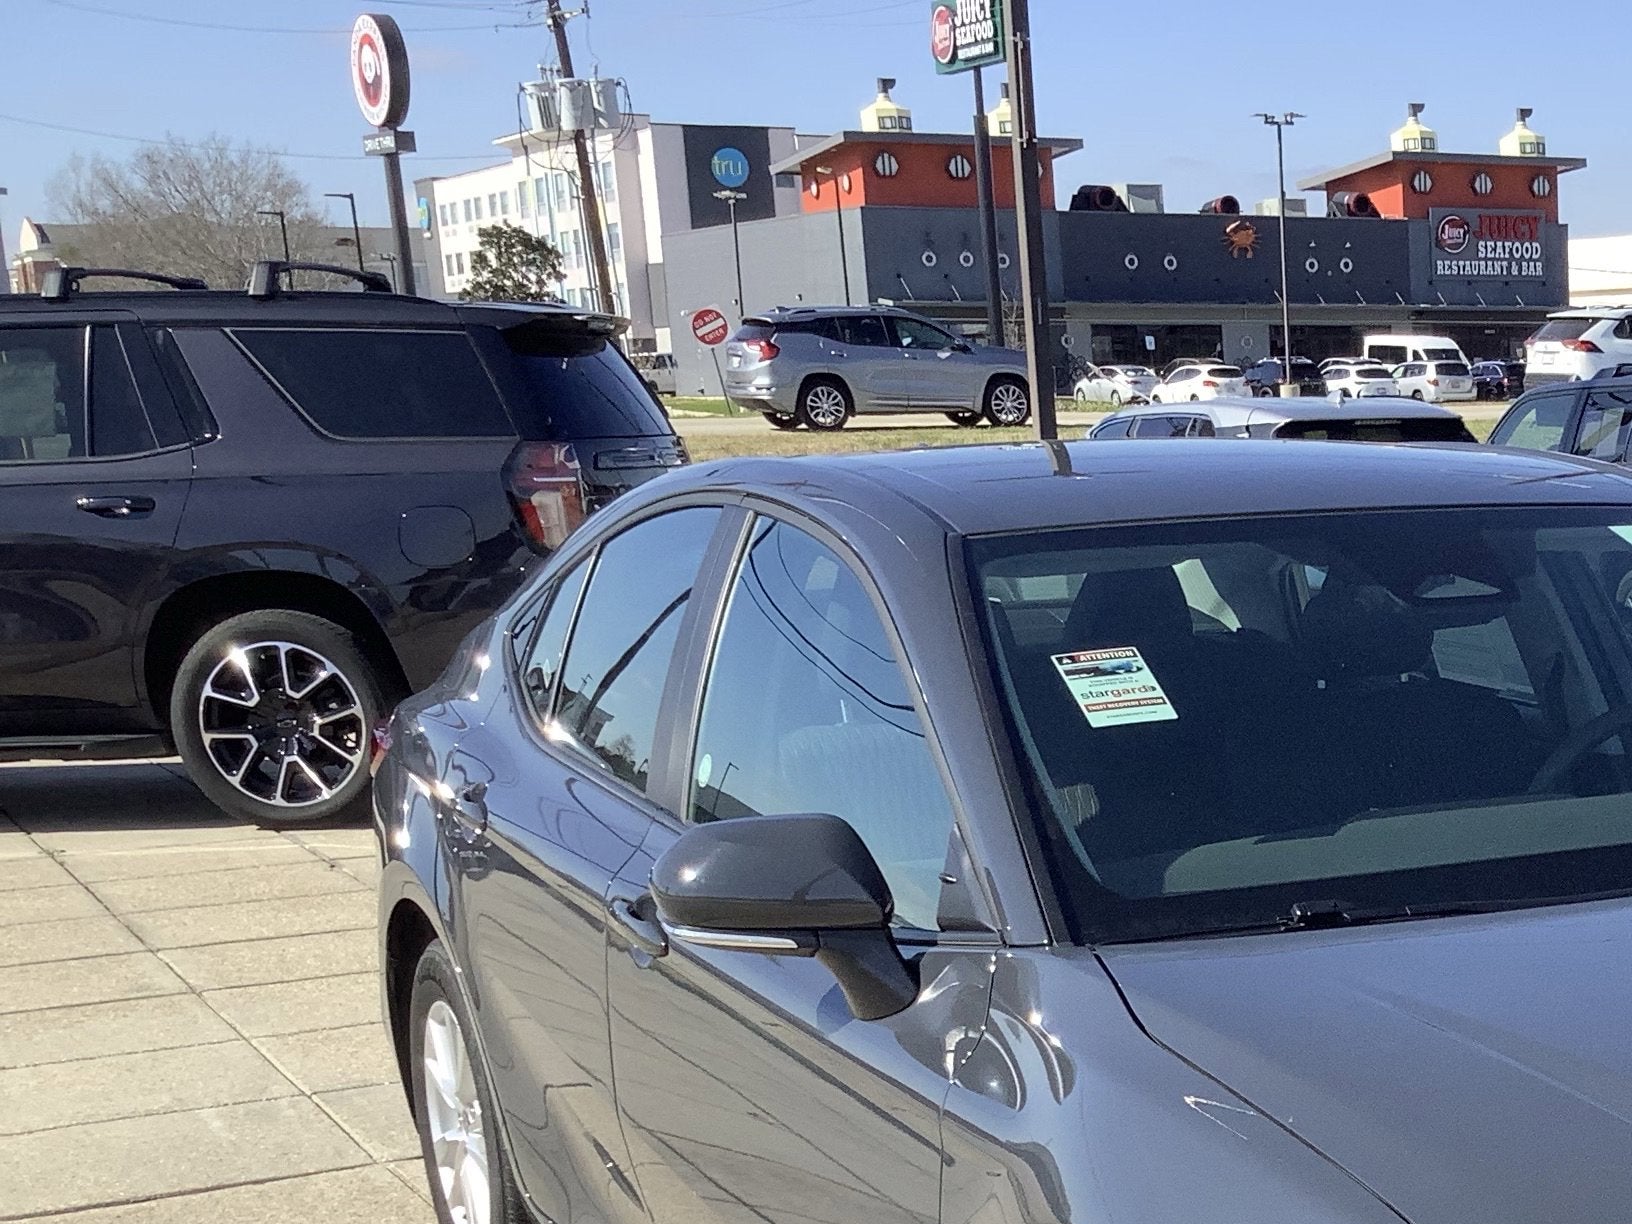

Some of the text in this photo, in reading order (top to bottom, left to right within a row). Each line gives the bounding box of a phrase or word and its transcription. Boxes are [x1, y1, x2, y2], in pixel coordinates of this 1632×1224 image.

[954, 0, 992, 27] JUICY
[955, 19, 994, 46] SEAFOOD
[712, 155, 743, 177] tru
[1472, 215, 1539, 241] JUICY
[1478, 241, 1541, 259] SEAFOOD
[1436, 260, 1543, 276] RESTAURANT & BAR
[693, 311, 718, 329] DO NOT
[704, 327, 725, 342] ENTER
[1079, 650, 1134, 662] ATTENTION
[1081, 685, 1147, 699] stargard
